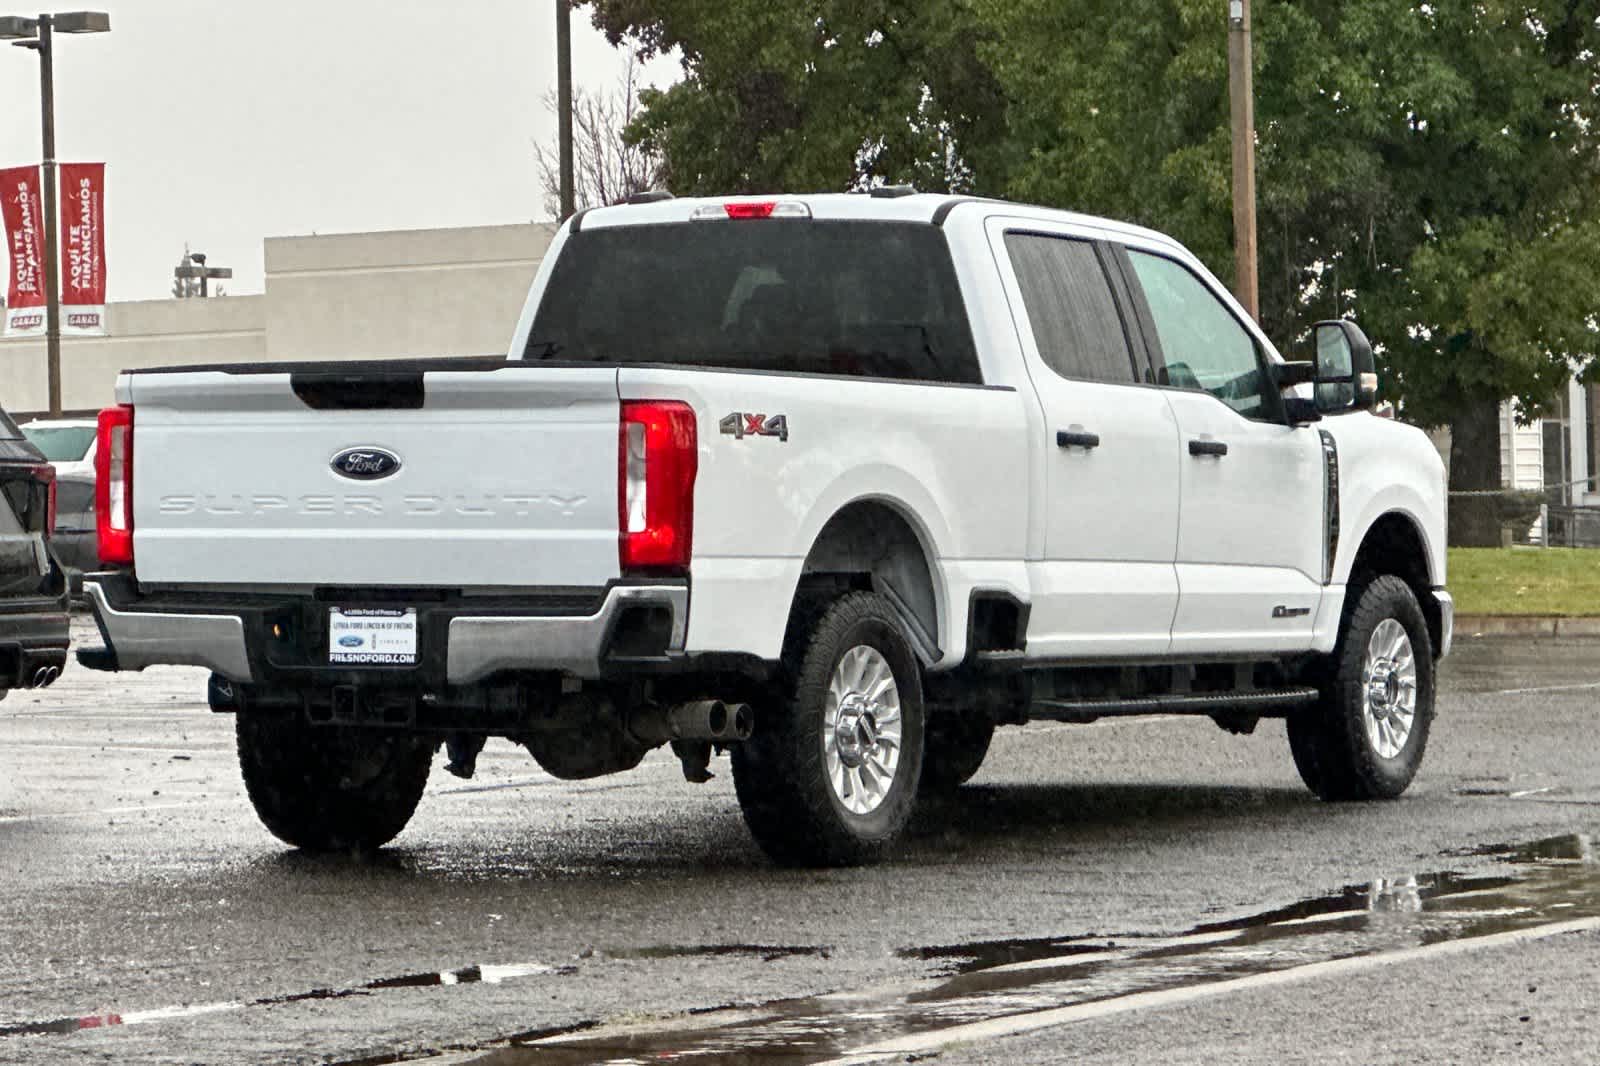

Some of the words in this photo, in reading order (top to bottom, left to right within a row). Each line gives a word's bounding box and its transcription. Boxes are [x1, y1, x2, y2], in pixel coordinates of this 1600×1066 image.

[14, 231, 23, 248] TE
[70, 225, 80, 244] TE
[80, 178, 91, 289] FINANCIAMOS
[344, 453, 383, 473] Ford
[159, 495, 385, 516] SUPER
[402, 495, 589, 516] DUTY
[330, 654, 415, 663] FRESNOFORD.COM
